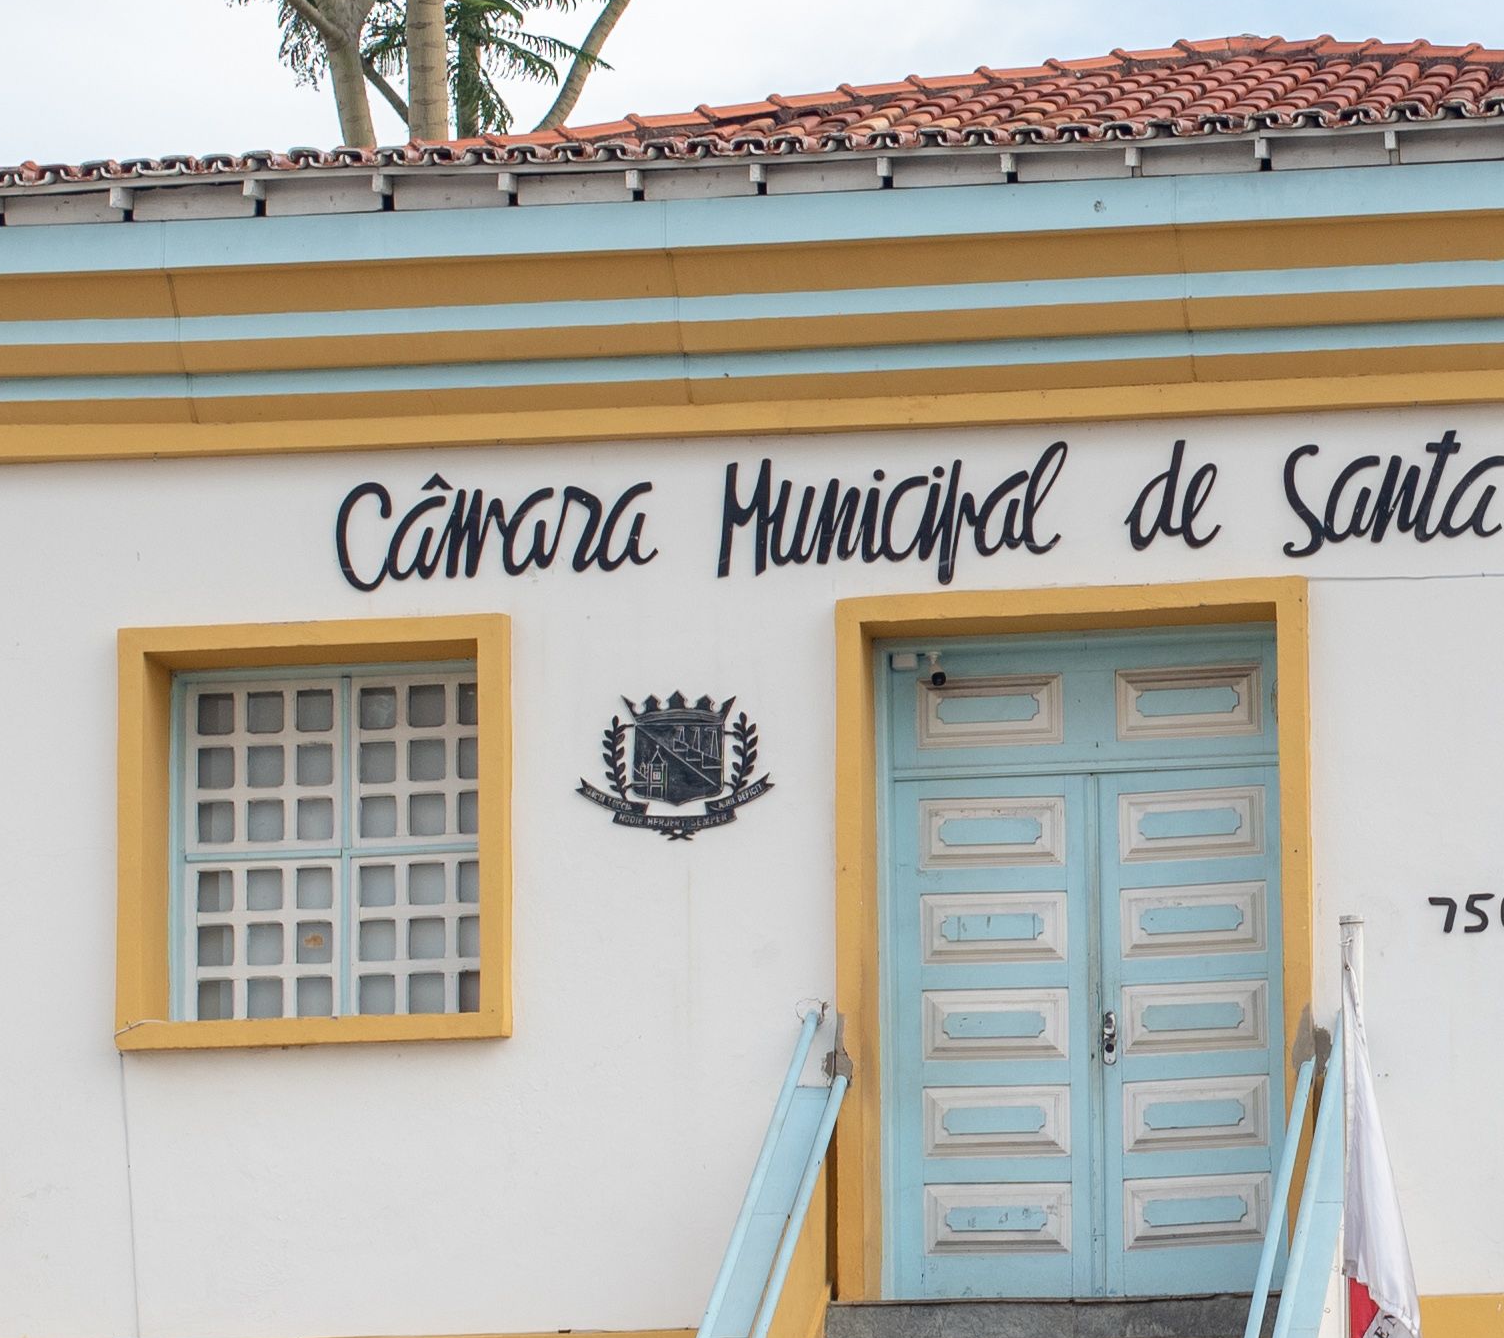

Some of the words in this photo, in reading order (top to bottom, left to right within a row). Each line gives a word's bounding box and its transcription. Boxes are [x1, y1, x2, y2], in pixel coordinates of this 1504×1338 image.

[336, 473, 658, 592] Câmara
[717, 441, 1068, 585] Municipal
[1124, 440, 1221, 551] de
